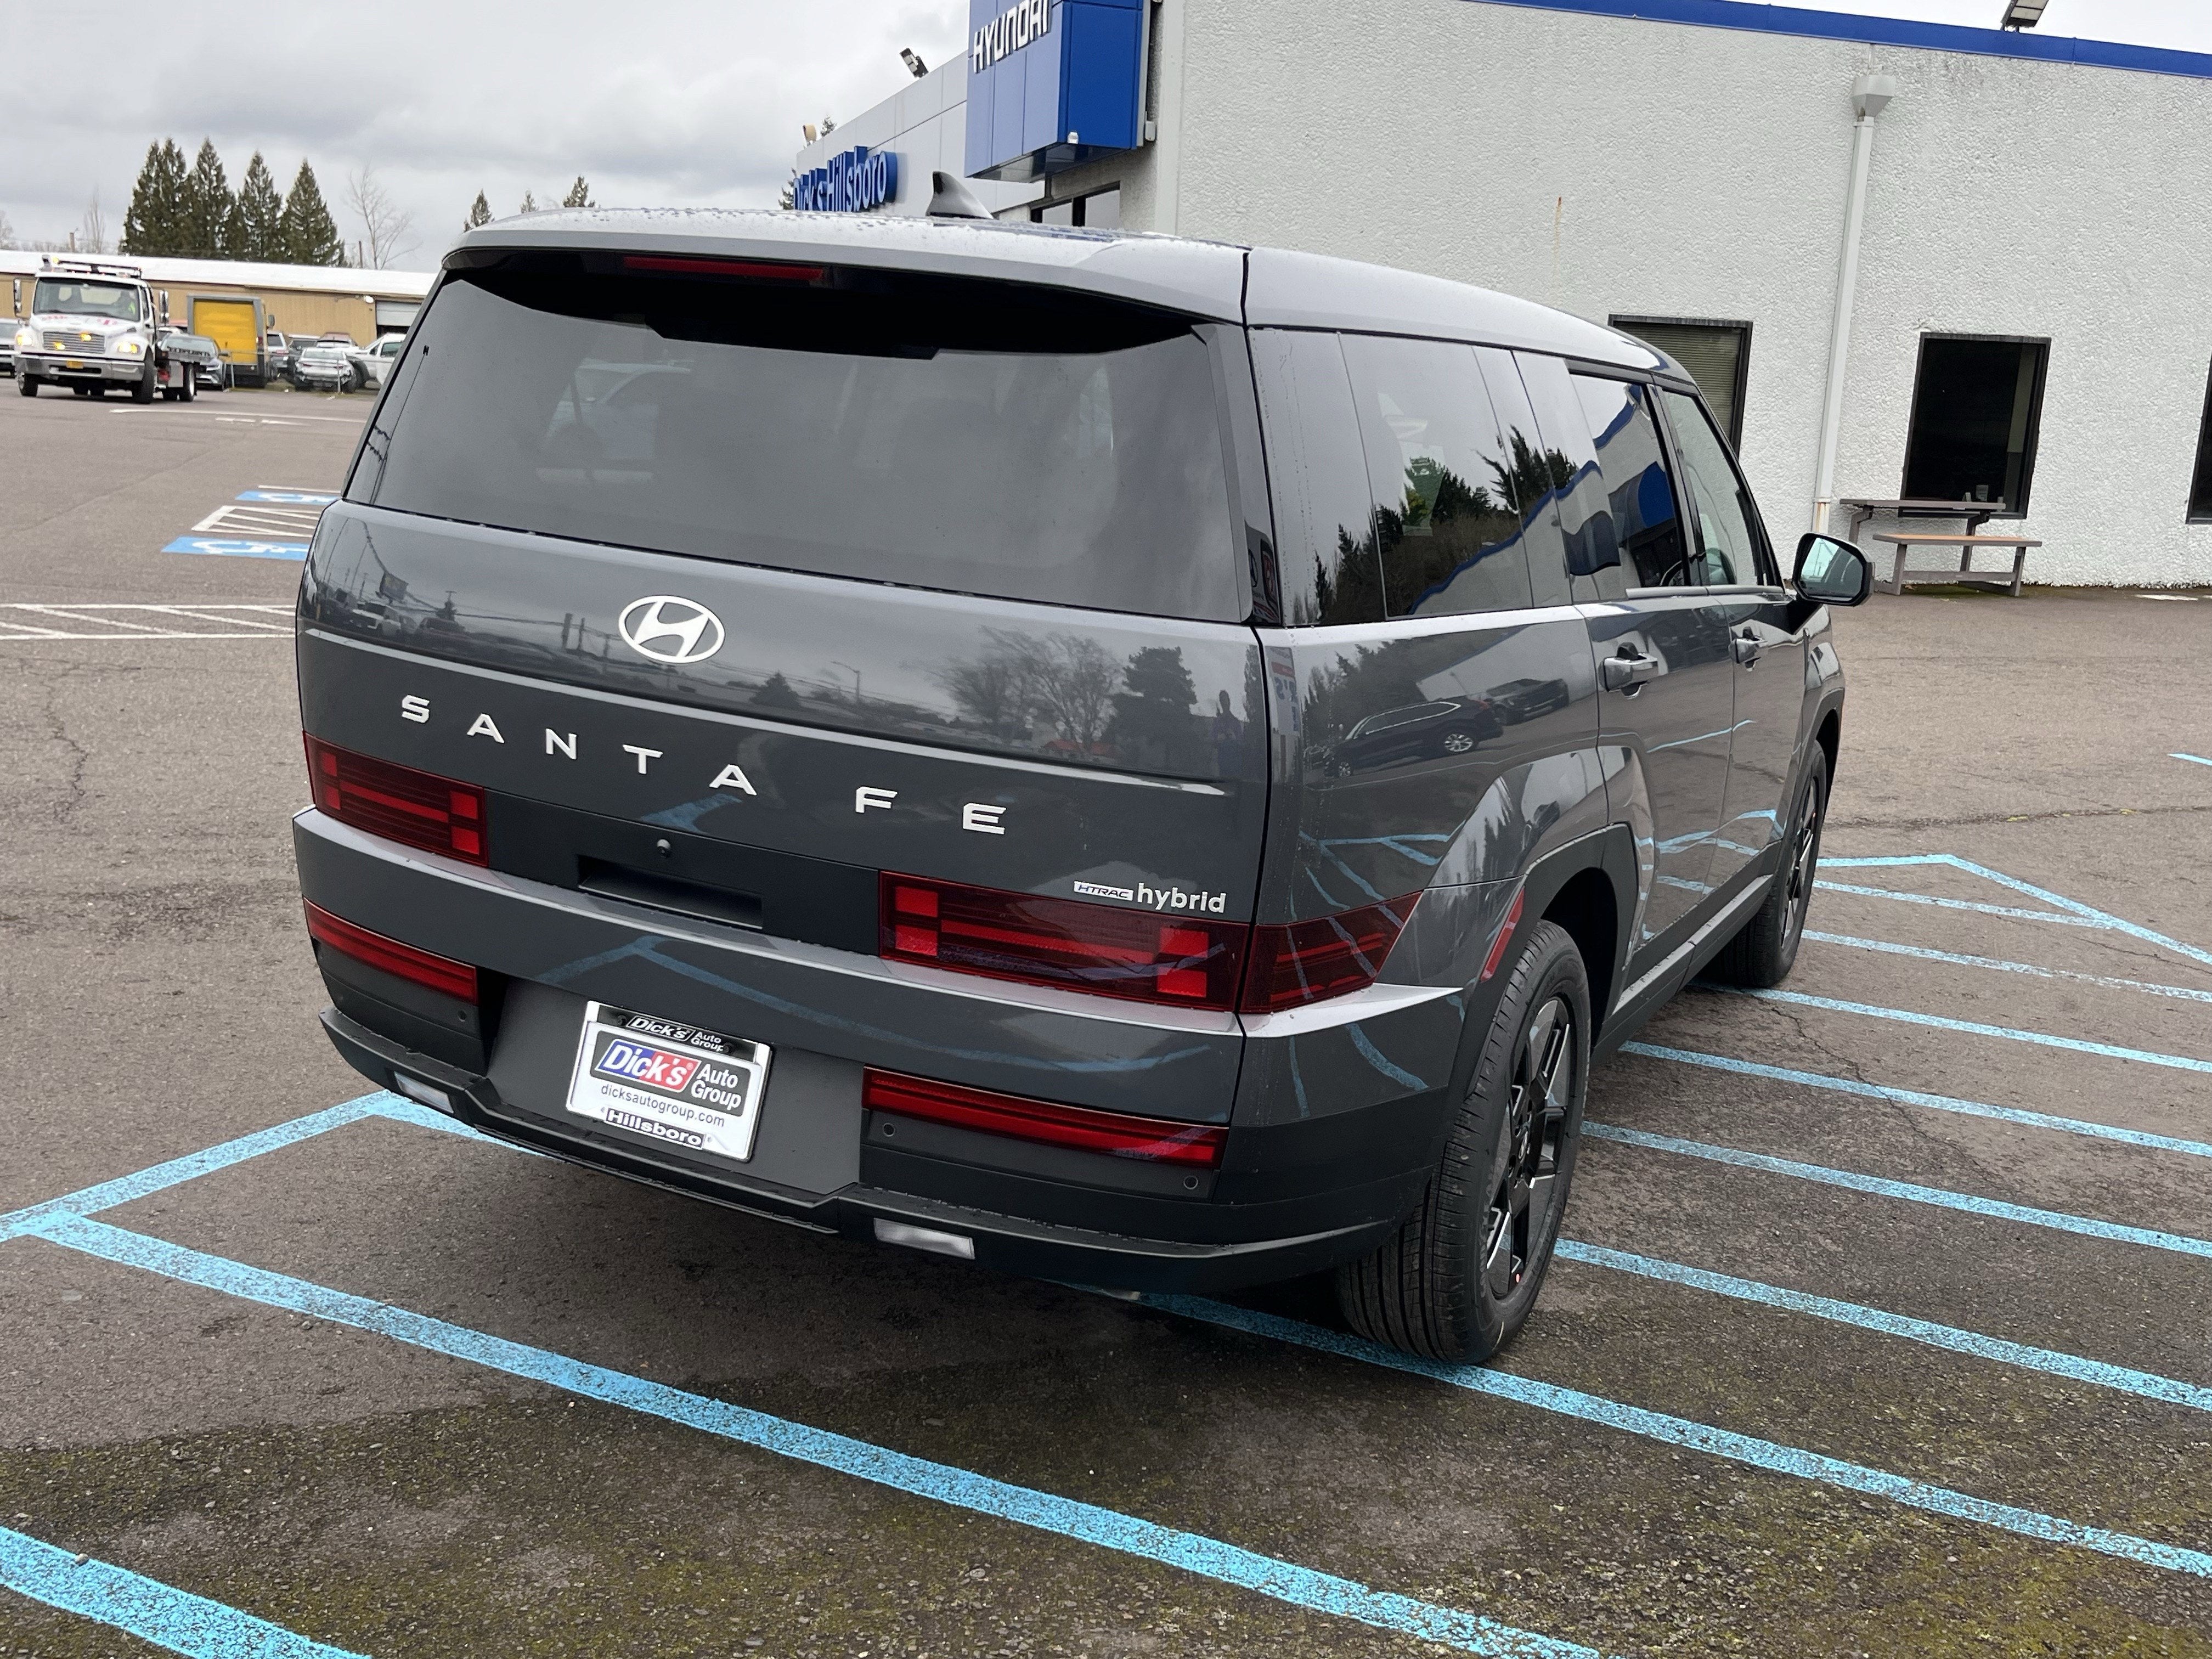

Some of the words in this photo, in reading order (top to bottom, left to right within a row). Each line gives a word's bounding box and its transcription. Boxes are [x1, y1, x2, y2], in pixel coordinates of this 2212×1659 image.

[827, 145, 892, 212] Hillsboro
[402, 695, 757, 796] SANTA
[855, 786, 1007, 835] FE
[1076, 883, 1130, 899] HTRAC
[1137, 882, 1227, 913] hybrid
[631, 1018, 688, 1040] Dick's
[695, 1031, 722, 1044] Auto
[603, 1043, 688, 1087] Dick's
[696, 1063, 738, 1089] Auto
[601, 1084, 725, 1127] dicksautogroup.com
[691, 1079, 742, 1111] Group
[608, 1109, 703, 1147] Hillsboro
